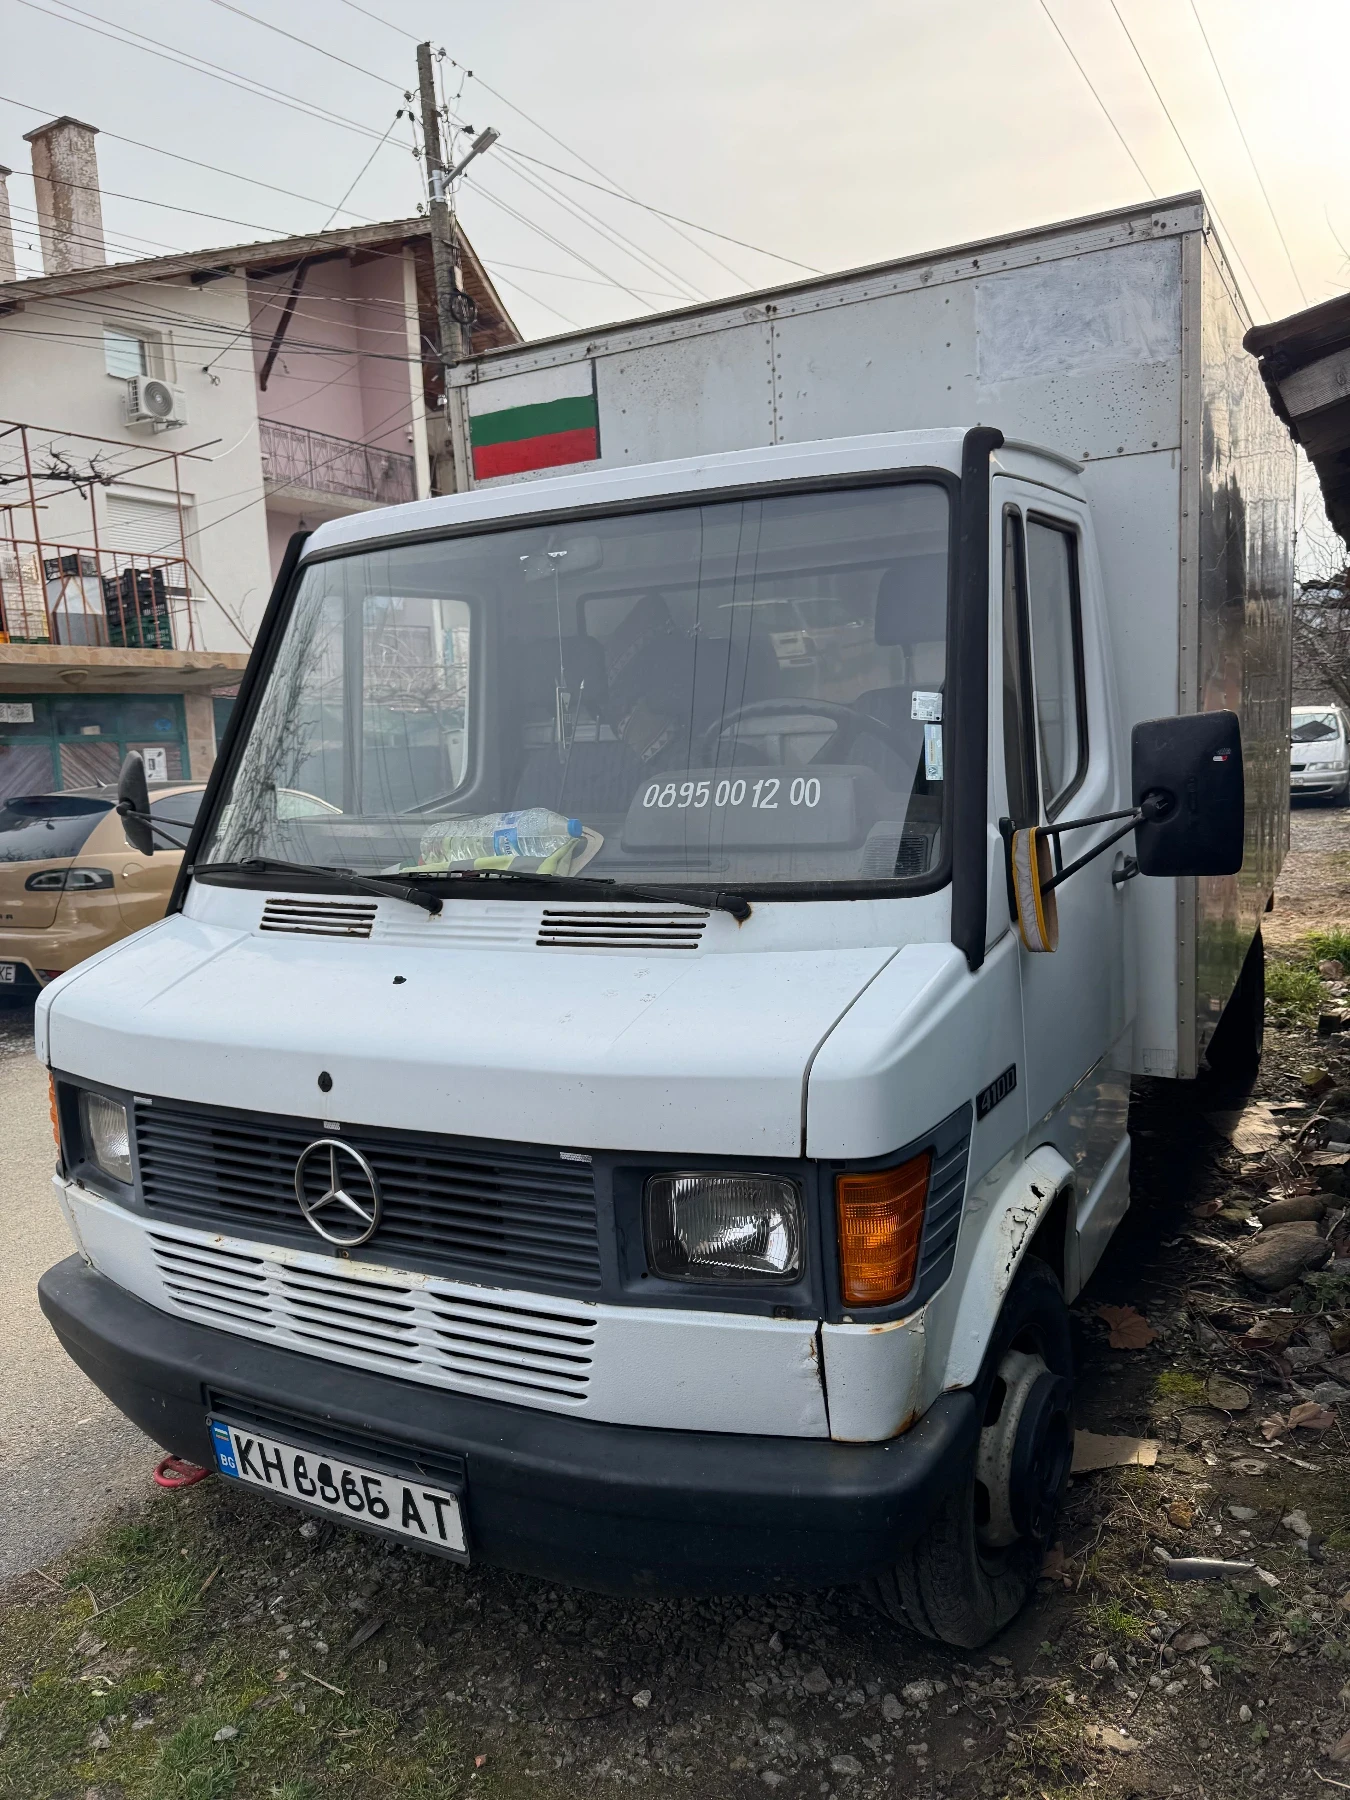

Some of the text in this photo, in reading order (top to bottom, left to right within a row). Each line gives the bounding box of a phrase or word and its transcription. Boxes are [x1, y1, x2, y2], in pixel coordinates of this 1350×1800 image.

[643, 777, 821, 809] 0895 00 12 00
[220, 1453, 236, 1470] BG
